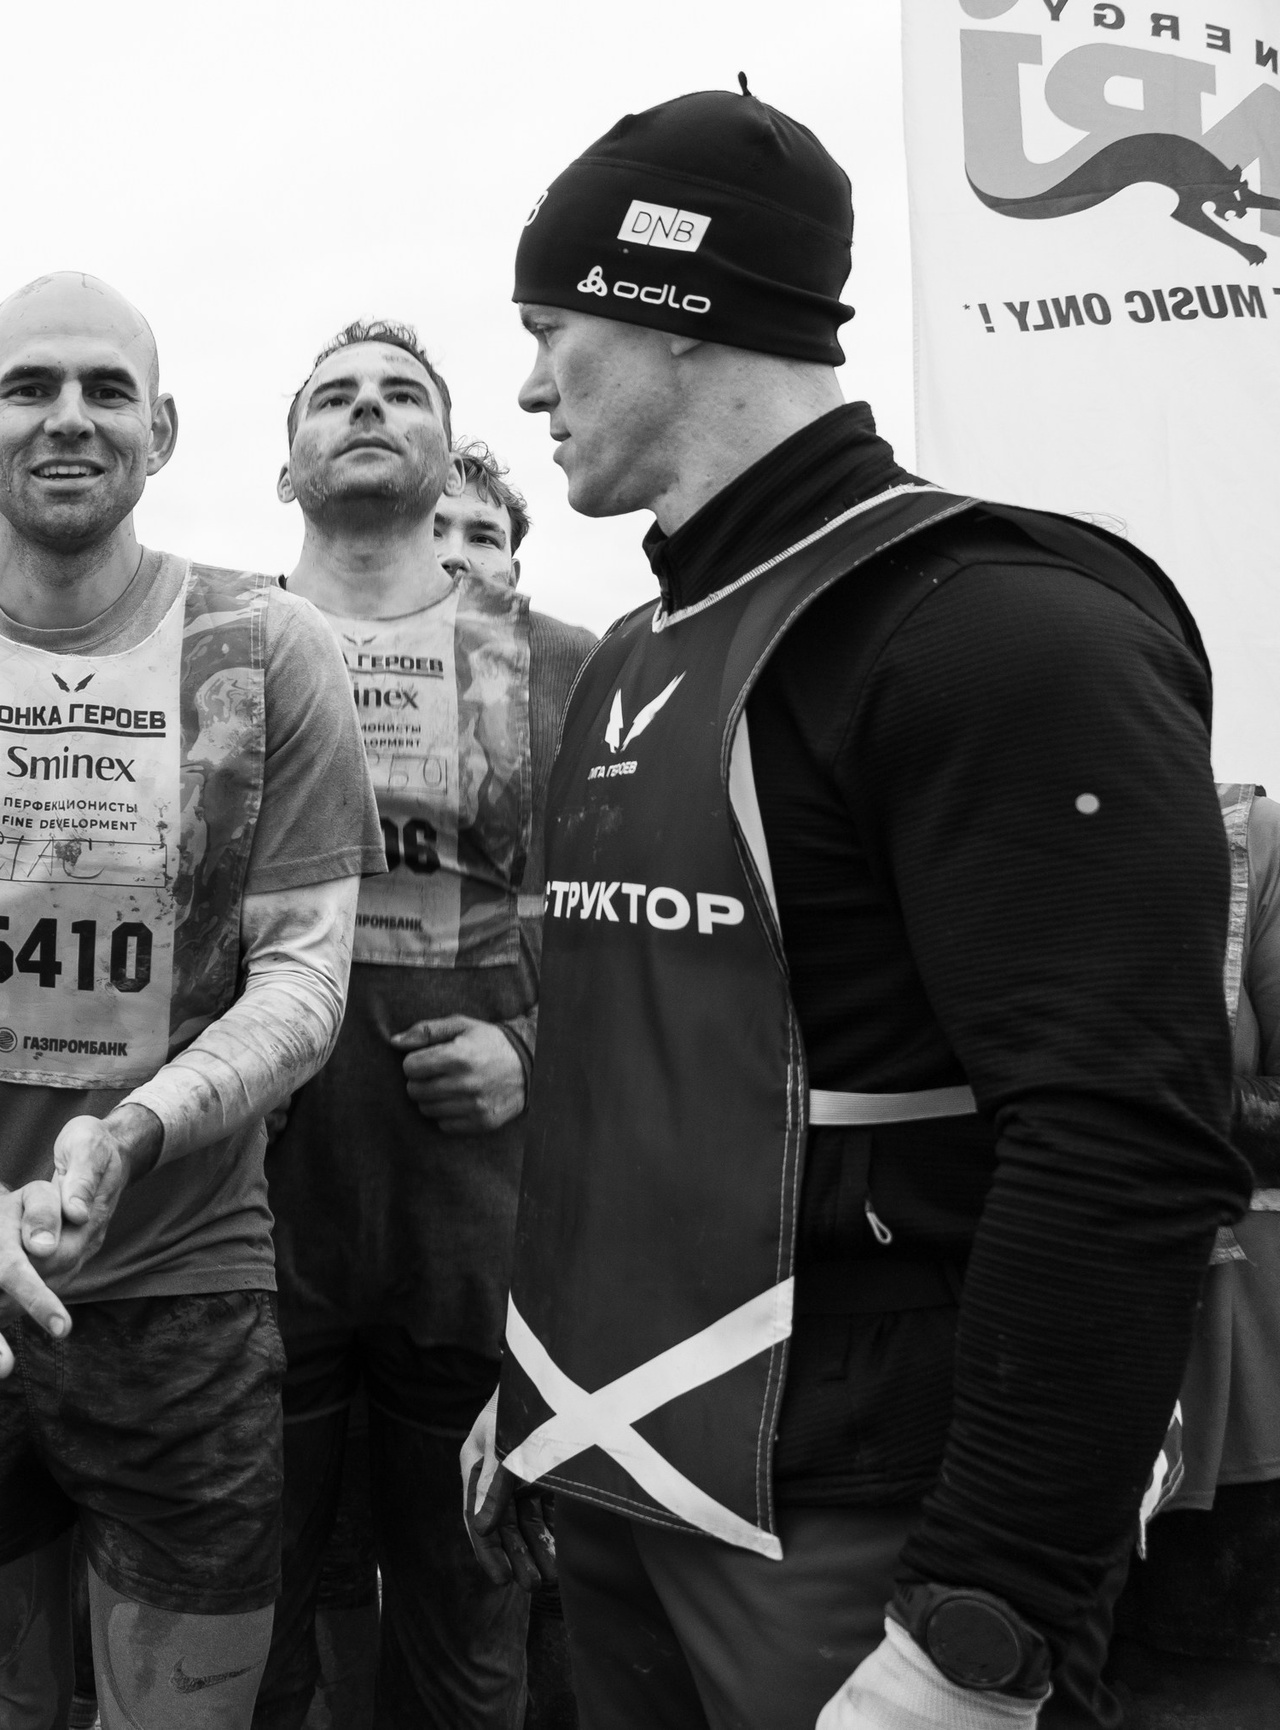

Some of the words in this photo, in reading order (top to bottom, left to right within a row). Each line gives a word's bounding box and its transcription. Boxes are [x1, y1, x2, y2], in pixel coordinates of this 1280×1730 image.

[631, 209, 695, 244] DNB
[613, 281, 711, 313] odlo
[353, 682, 418, 710] inex
[68, 704, 166, 730] ГЕРОЕВ
[6, 746, 136, 782] Sminex
[4, 797, 137, 813] ПЕРФЕКЦИОНИСТЫ
[2, 815, 33, 828] FINE
[40, 819, 137, 831] DEVELOPMENT
[545, 880, 744, 934] ТРУКТОР
[355, 914, 422, 932] ПРОМБАНК
[23, 1035, 128, 1057] ГАЗПРОМБАНК
